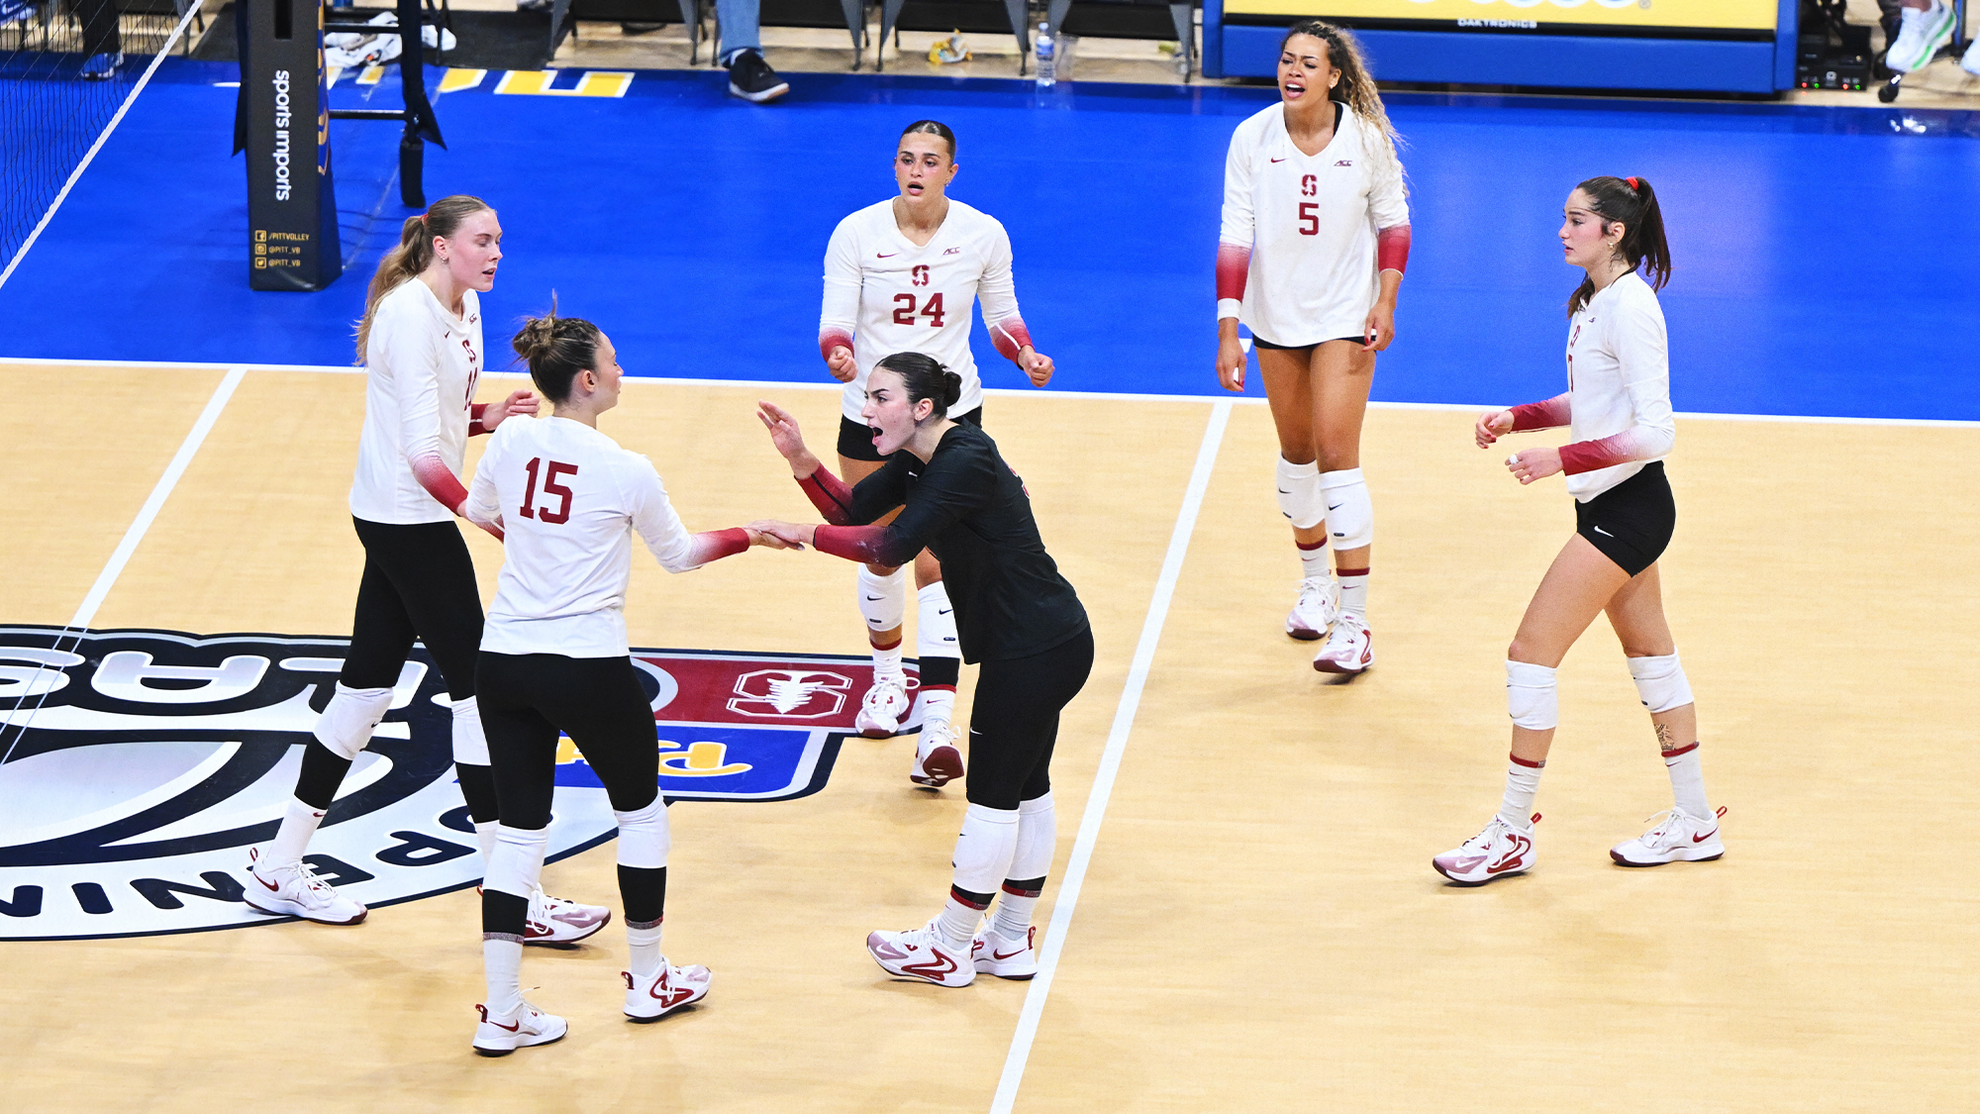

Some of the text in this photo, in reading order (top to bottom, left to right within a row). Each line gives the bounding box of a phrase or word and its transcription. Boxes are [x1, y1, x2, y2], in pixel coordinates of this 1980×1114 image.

[1457, 18, 1537, 29] DAKTRONICS
[272, 69, 292, 201] sports imports
[1299, 202, 1319, 235] 5
[942, 246, 960, 256] ACC
[893, 292, 945, 327] 24
[519, 456, 579, 525] 15
